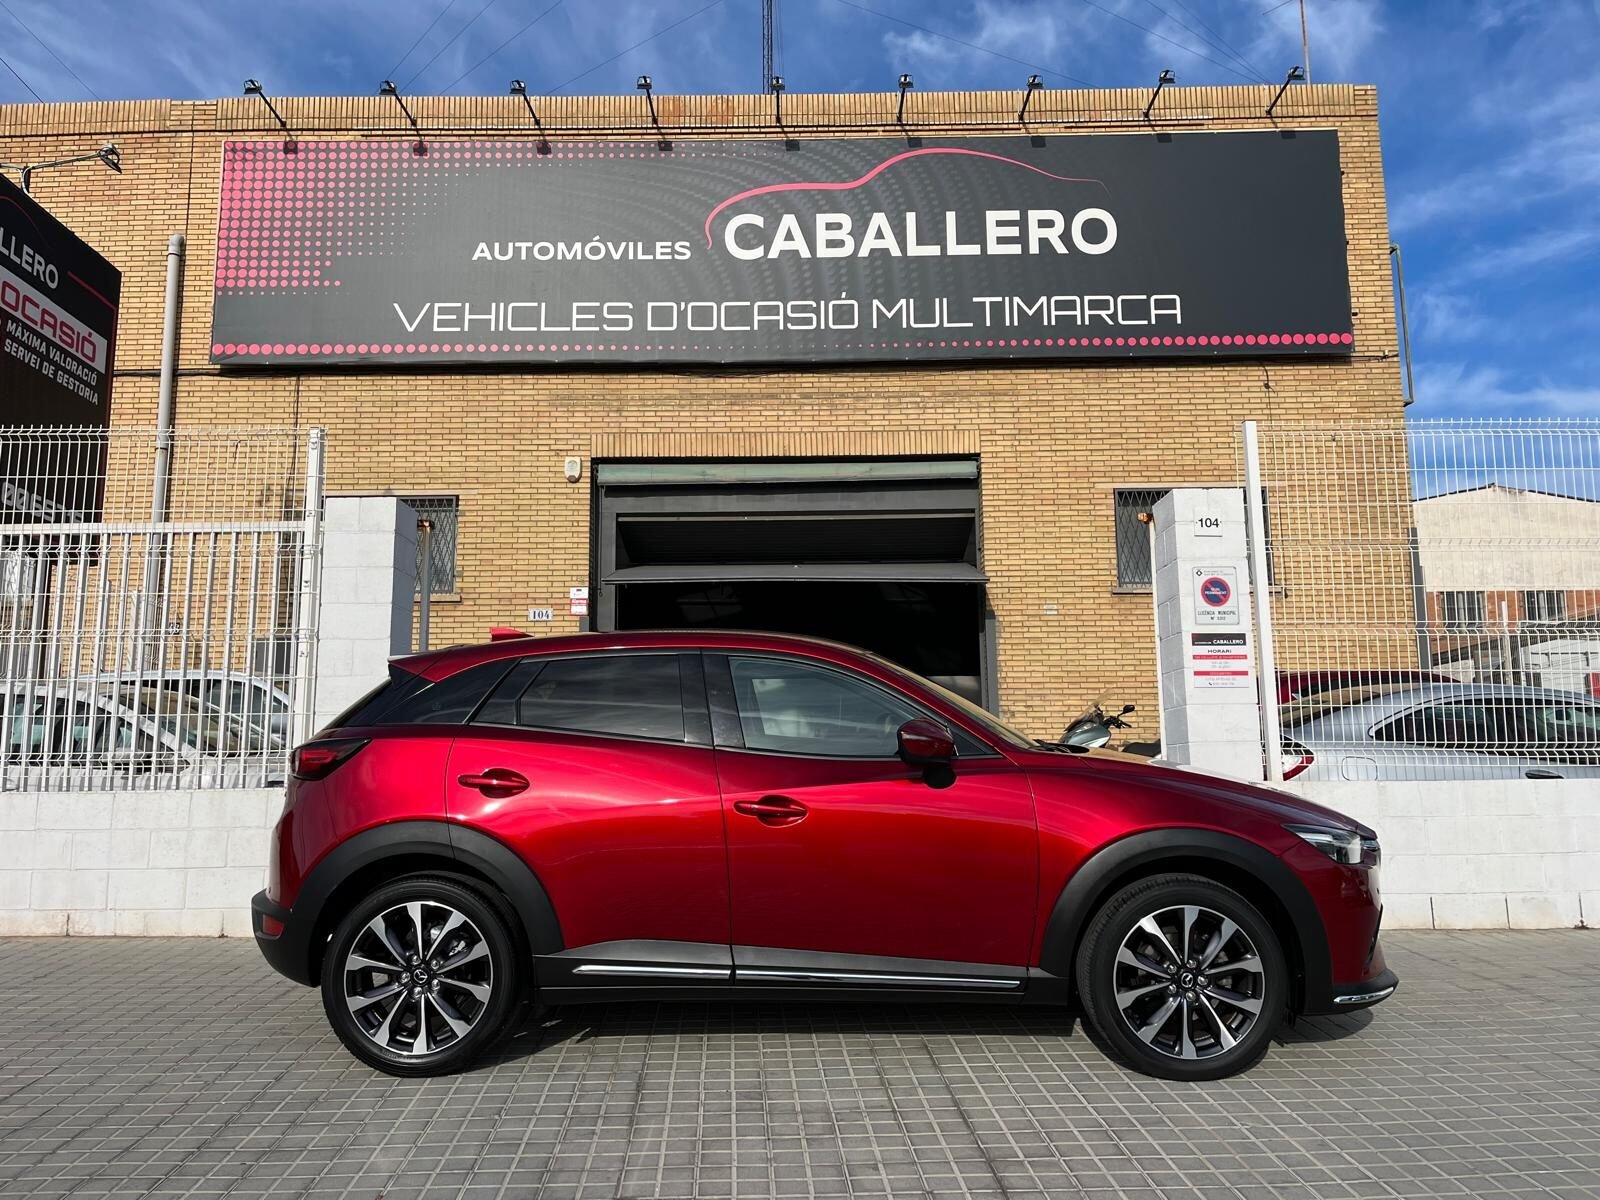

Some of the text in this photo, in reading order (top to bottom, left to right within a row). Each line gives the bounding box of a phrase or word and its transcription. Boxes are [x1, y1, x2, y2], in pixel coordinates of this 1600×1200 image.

[472, 207, 1118, 261] AUTOMÓVILES CABALLERO
[1, 280, 96, 364] OCASIÓ
[393, 292, 1182, 332] VEHICLES D'OCASIÓ MULTIMARCA
[4, 338, 99, 406] SERVEI DE GESTORIA
[49, 345, 97, 386] VALORACIÓ
[1198, 517, 1220, 528] 104
[532, 610, 550, 620] 104
